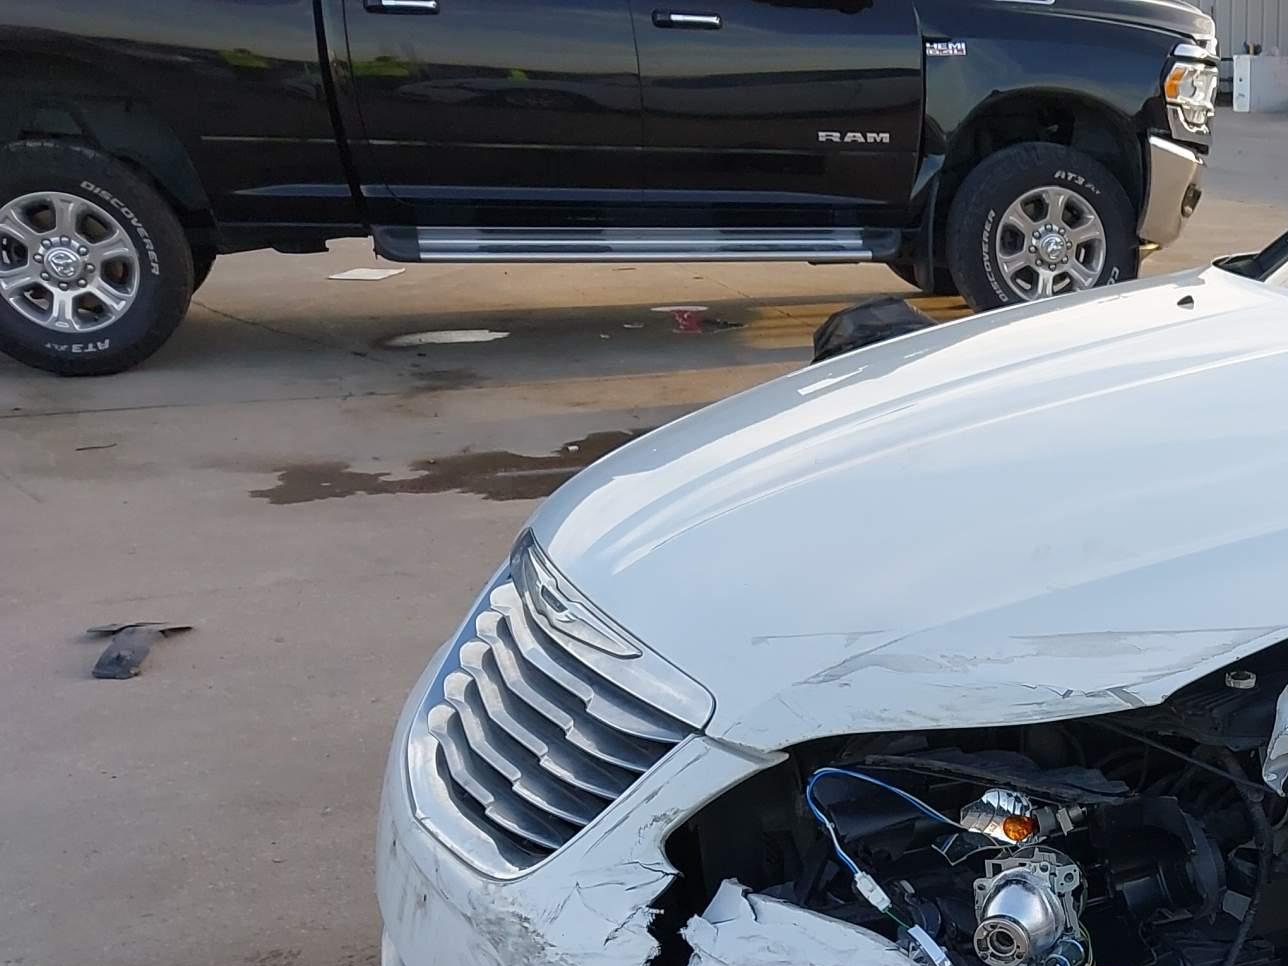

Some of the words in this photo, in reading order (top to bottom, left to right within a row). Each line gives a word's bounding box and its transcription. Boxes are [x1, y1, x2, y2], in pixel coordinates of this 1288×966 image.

[925, 42, 966, 51] HEMI
[818, 131, 890, 143] RAM
[1054, 170, 1085, 185] AT3
[80, 180, 161, 276] DISCOVERER
[982, 209, 1009, 302] DISCOVERER
[71, 338, 110, 353] AT3
